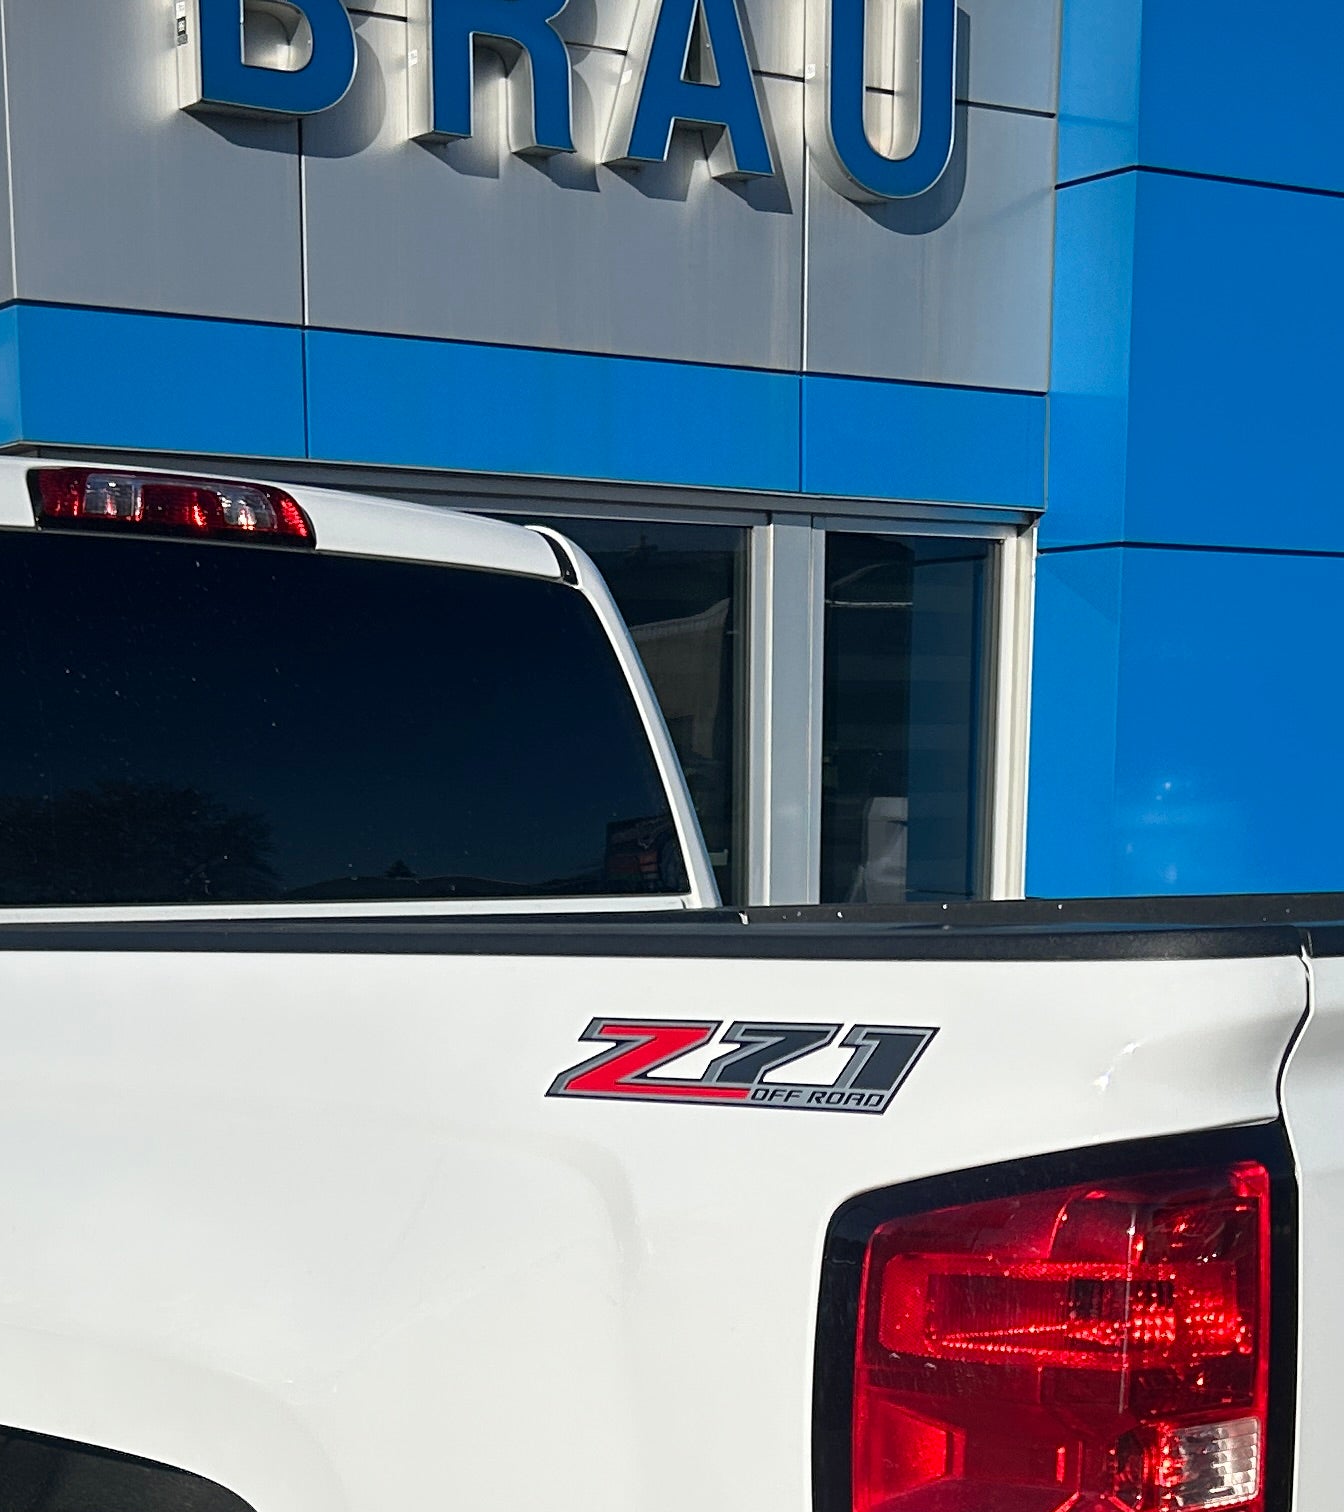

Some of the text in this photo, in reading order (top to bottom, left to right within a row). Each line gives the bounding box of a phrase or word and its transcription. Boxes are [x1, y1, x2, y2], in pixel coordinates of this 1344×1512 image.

[545, 1017, 941, 1115] Z71
[750, 1088, 886, 1109] OFF ROAD
